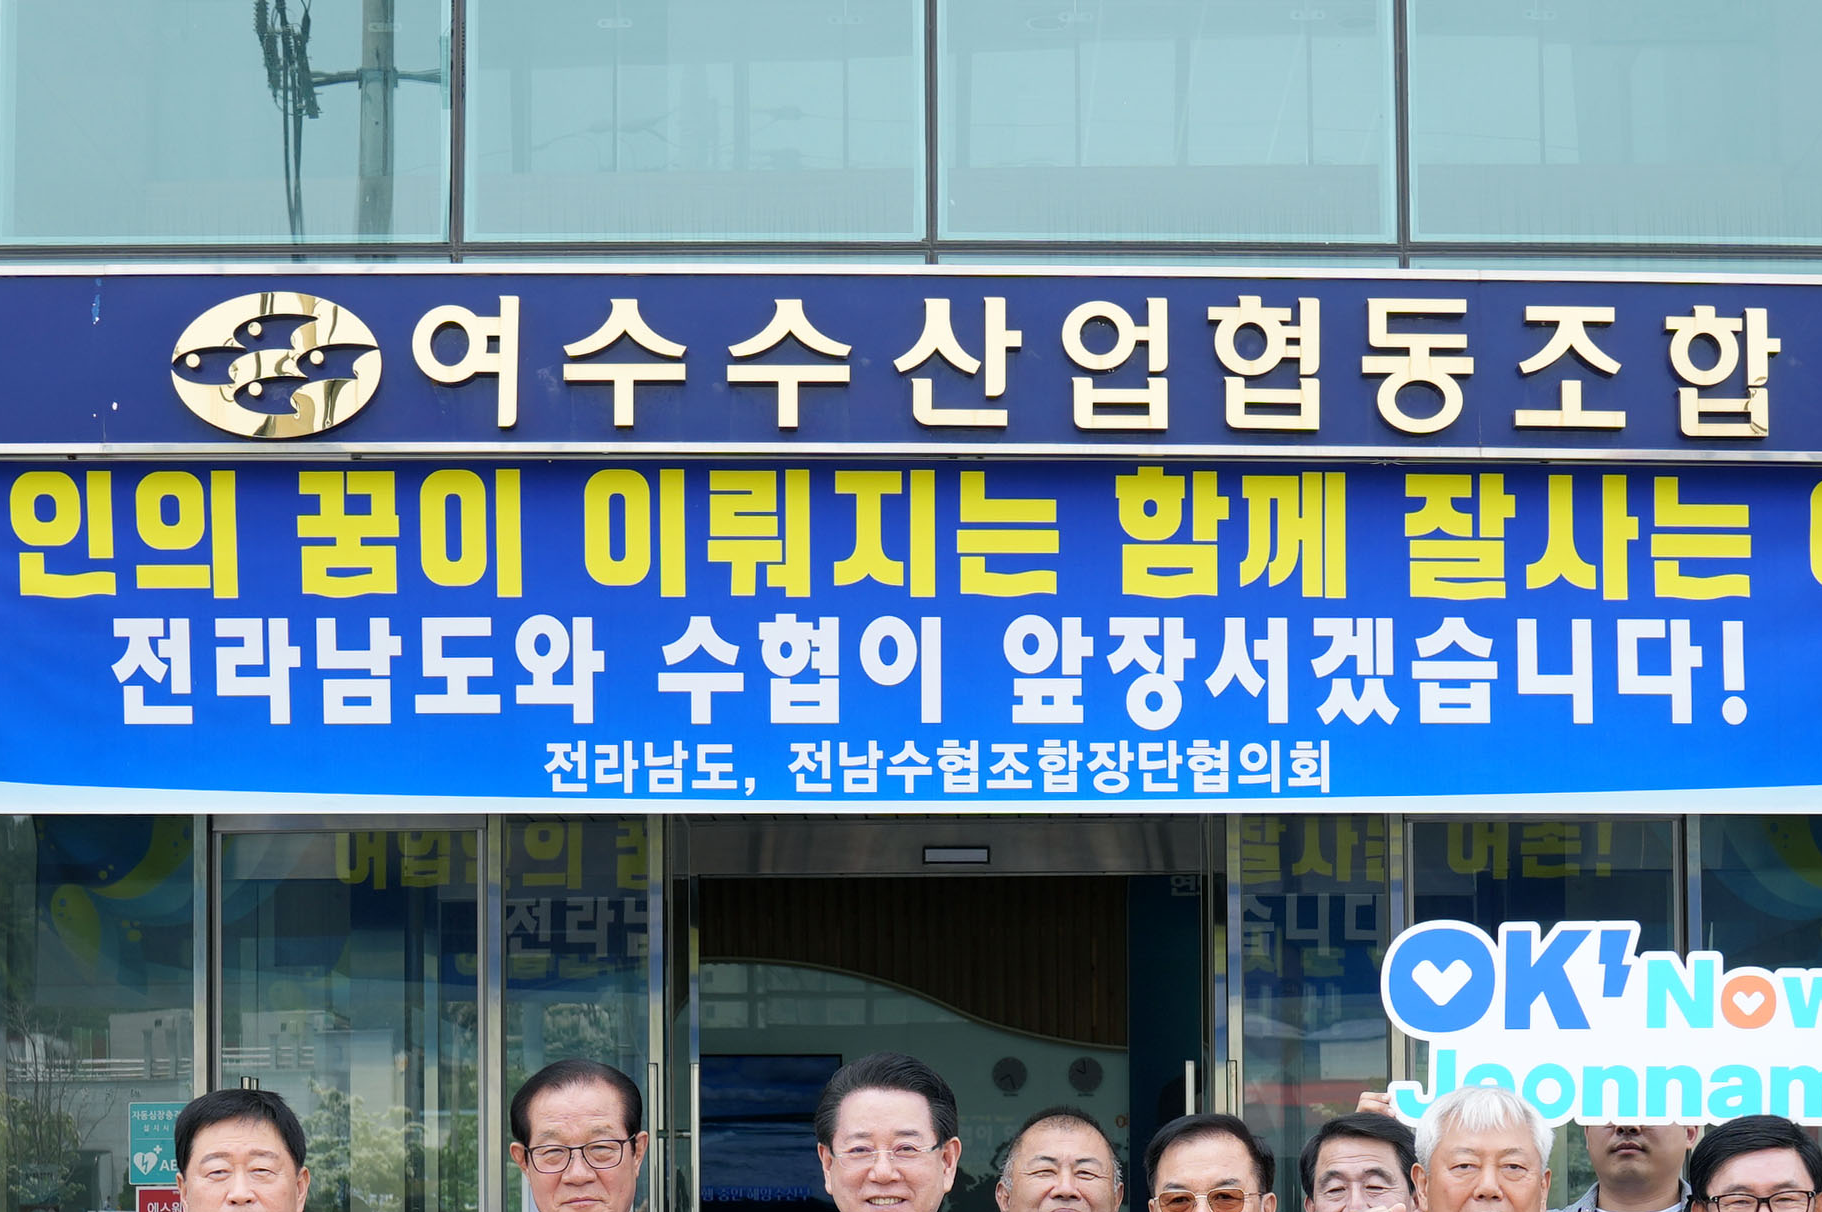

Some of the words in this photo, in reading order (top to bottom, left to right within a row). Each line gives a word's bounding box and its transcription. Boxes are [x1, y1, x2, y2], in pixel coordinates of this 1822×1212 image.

[411, 294, 1784, 440] 여수수산업협동조합
[297, 469, 522, 598] 꿈이
[584, 469, 1060, 598] 이뤄지는
[1115, 467, 1347, 599] 함께
[1405, 472, 1753, 600] 잘사는
[112, 613, 605, 726] 전라남도와
[658, 612, 942, 726] 수협이
[1003, 614, 1748, 727] 앞장서겠습니다!
[543, 738, 756, 793] 전라남도,
[787, 738, 1332, 793] 전남수협조합장단협의회
